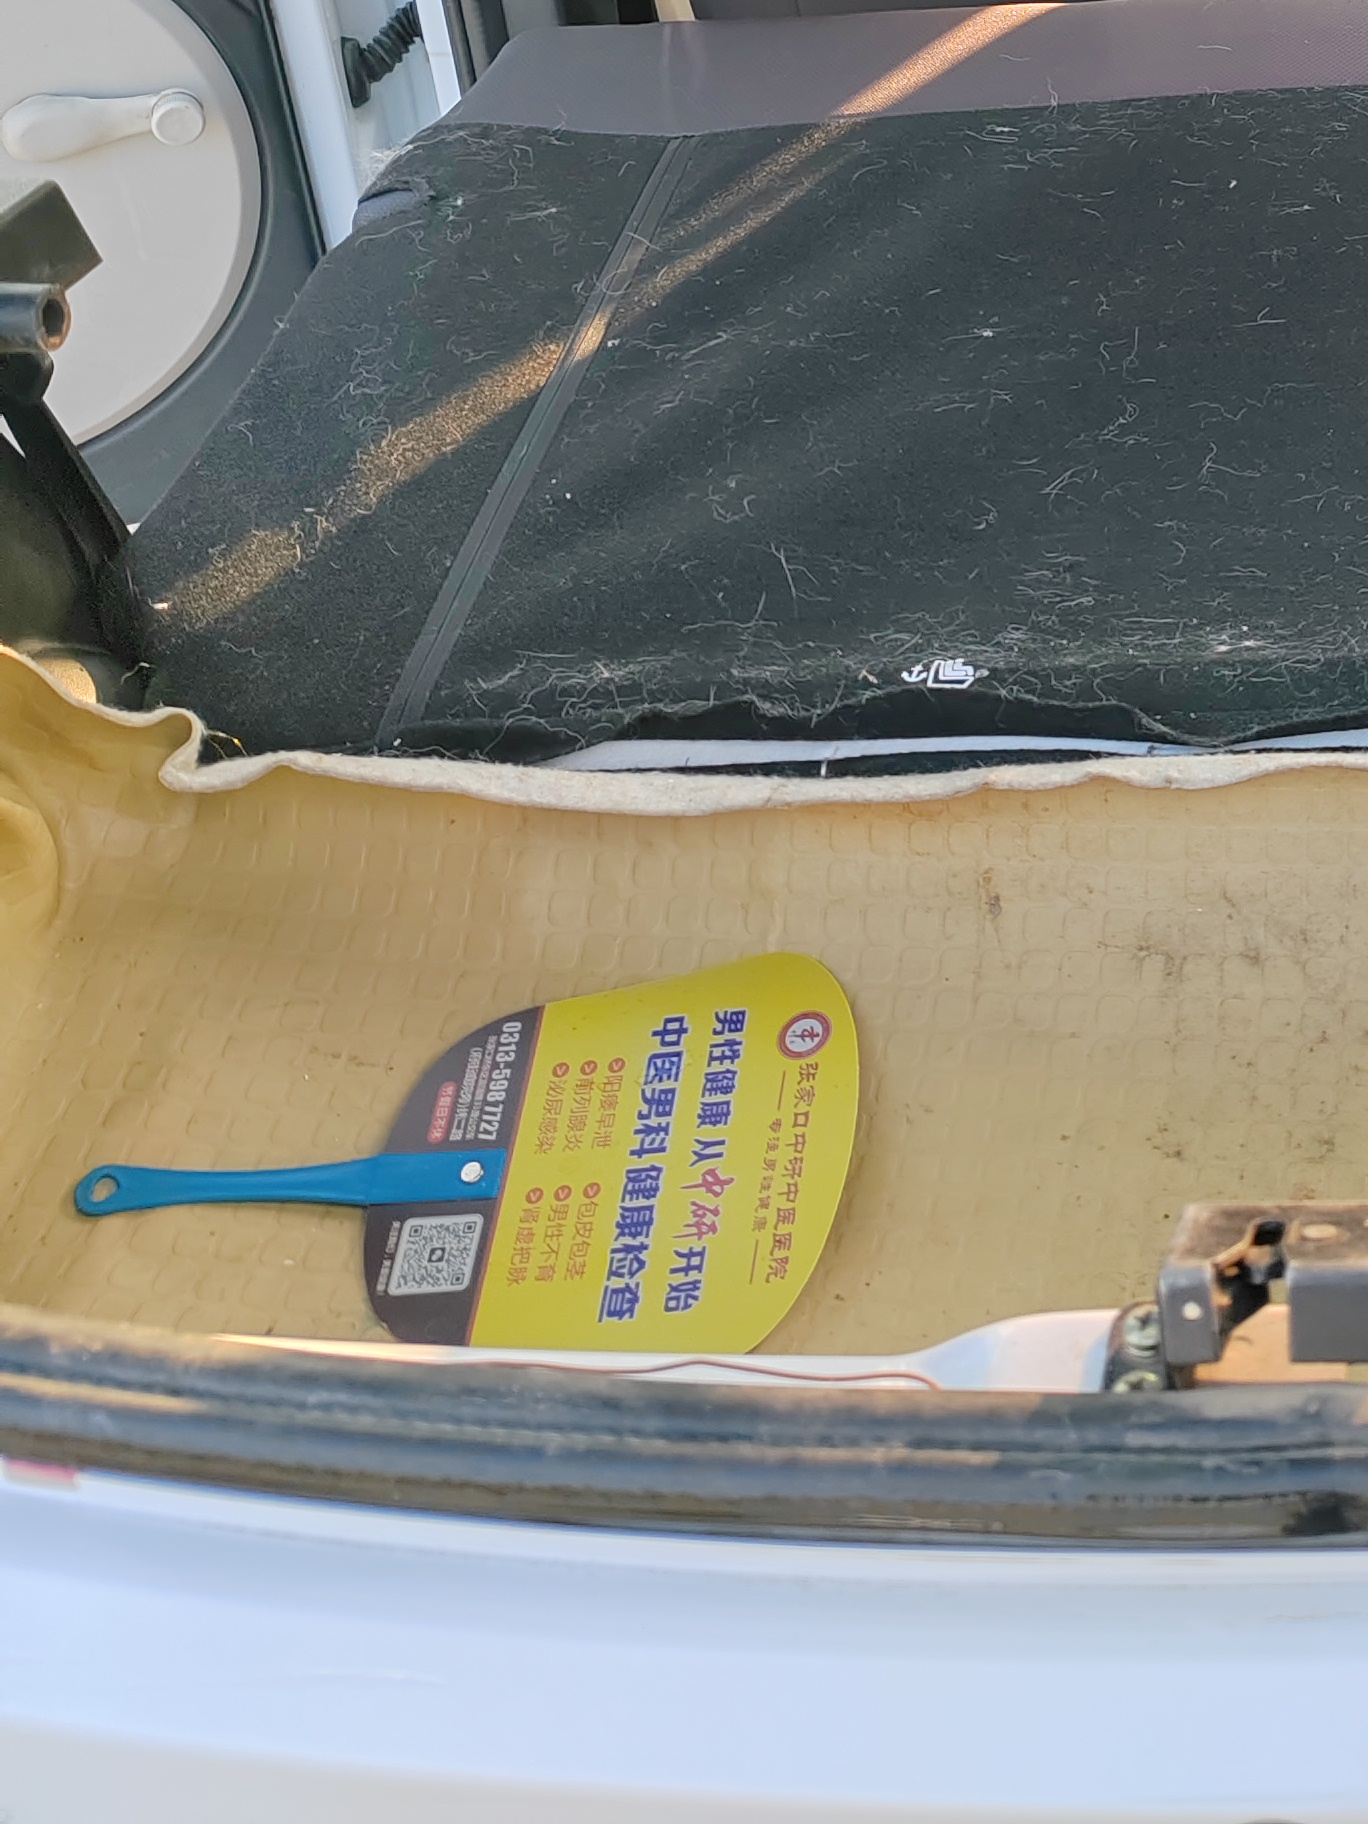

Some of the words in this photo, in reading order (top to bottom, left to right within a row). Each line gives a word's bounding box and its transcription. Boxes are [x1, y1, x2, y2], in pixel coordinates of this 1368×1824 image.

[534, 1079, 567, 1156] 泌尿感染
[562, 1077, 596, 1153] 前列腺炎
[751, 1117, 782, 1233] 专注男性健康
[765, 1061, 818, 1283] 张家口中研中医医院
[506, 1206, 541, 1288] 肾虚把脉
[534, 1203, 570, 1283] 男性不育
[564, 1200, 599, 1282] 包皮包茎
